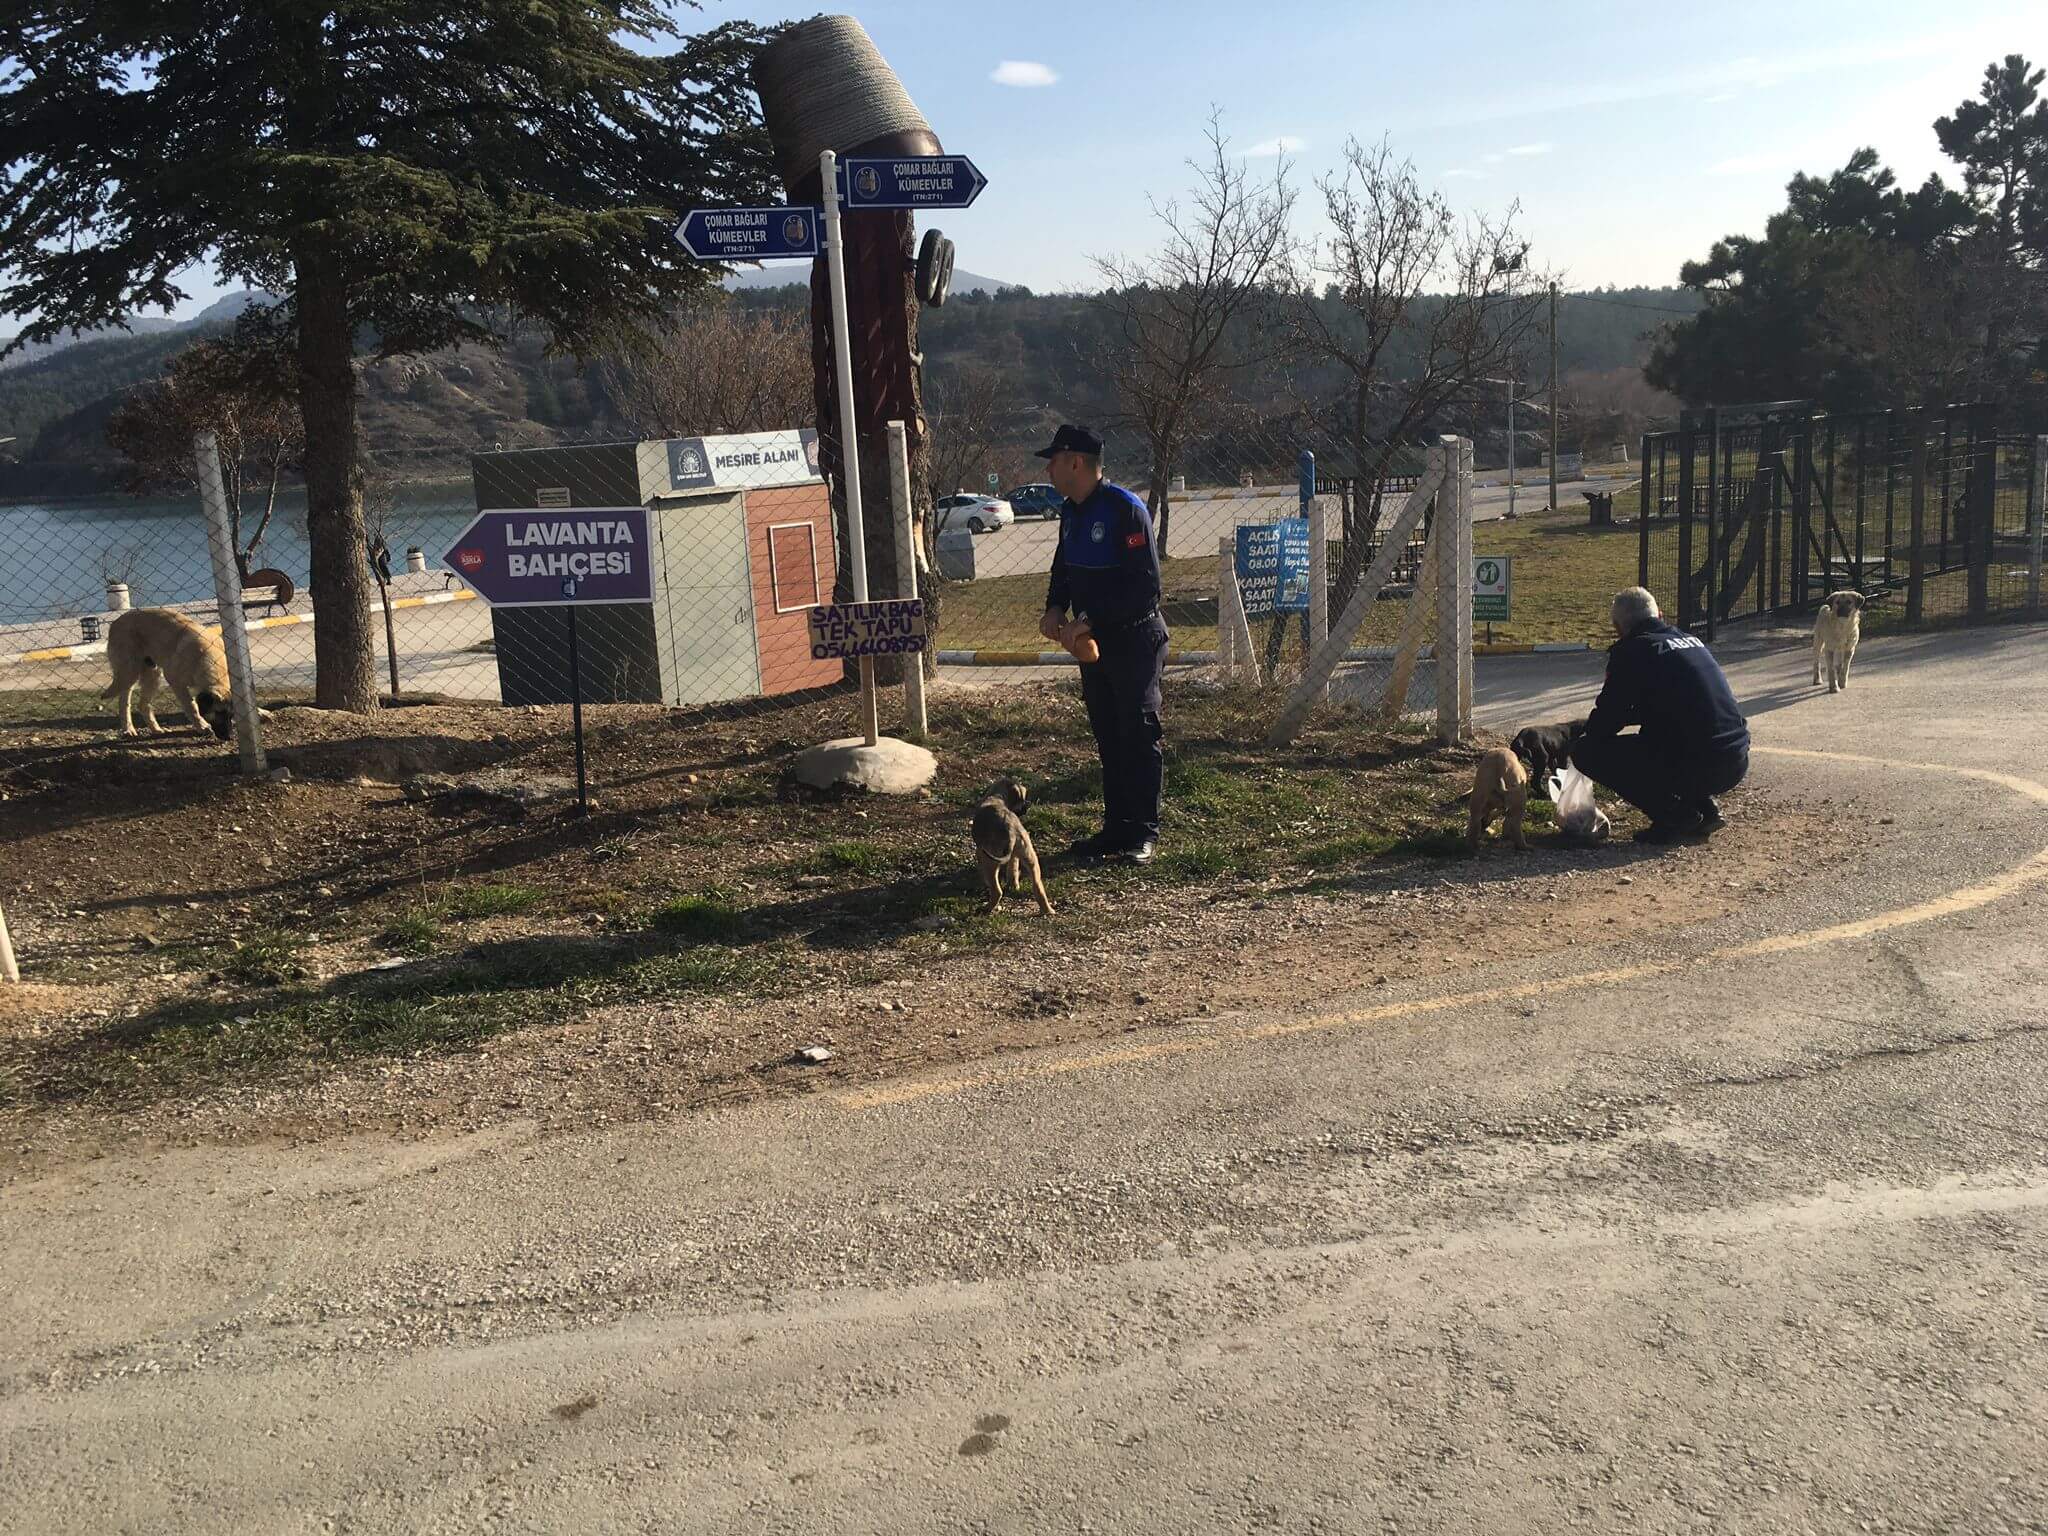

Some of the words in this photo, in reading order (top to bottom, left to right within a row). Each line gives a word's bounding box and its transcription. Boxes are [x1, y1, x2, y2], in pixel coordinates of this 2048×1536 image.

[893, 163, 920, 179] ÇOMAR
[922, 161, 954, 175] BAĞLARI
[899, 178, 954, 192] KÜMEEVLER
[912, 193, 943, 201] (TN:271)
[704, 215, 733, 231] ÇOMAR
[734, 211, 768, 226] BAĞLARI
[708, 229, 767, 243] KÜMEEVLER
[723, 245, 755, 253] (TN:271)
[763, 449, 799, 465] ALANI
[505, 521, 634, 547] LAVANTA
[1248, 557, 1278, 569] 08.00
[812, 602, 887, 624] SATILIK
[1245, 601, 1273, 613] 22.00
[813, 621, 858, 641] TEK
[861, 618, 913, 637] TAPU
